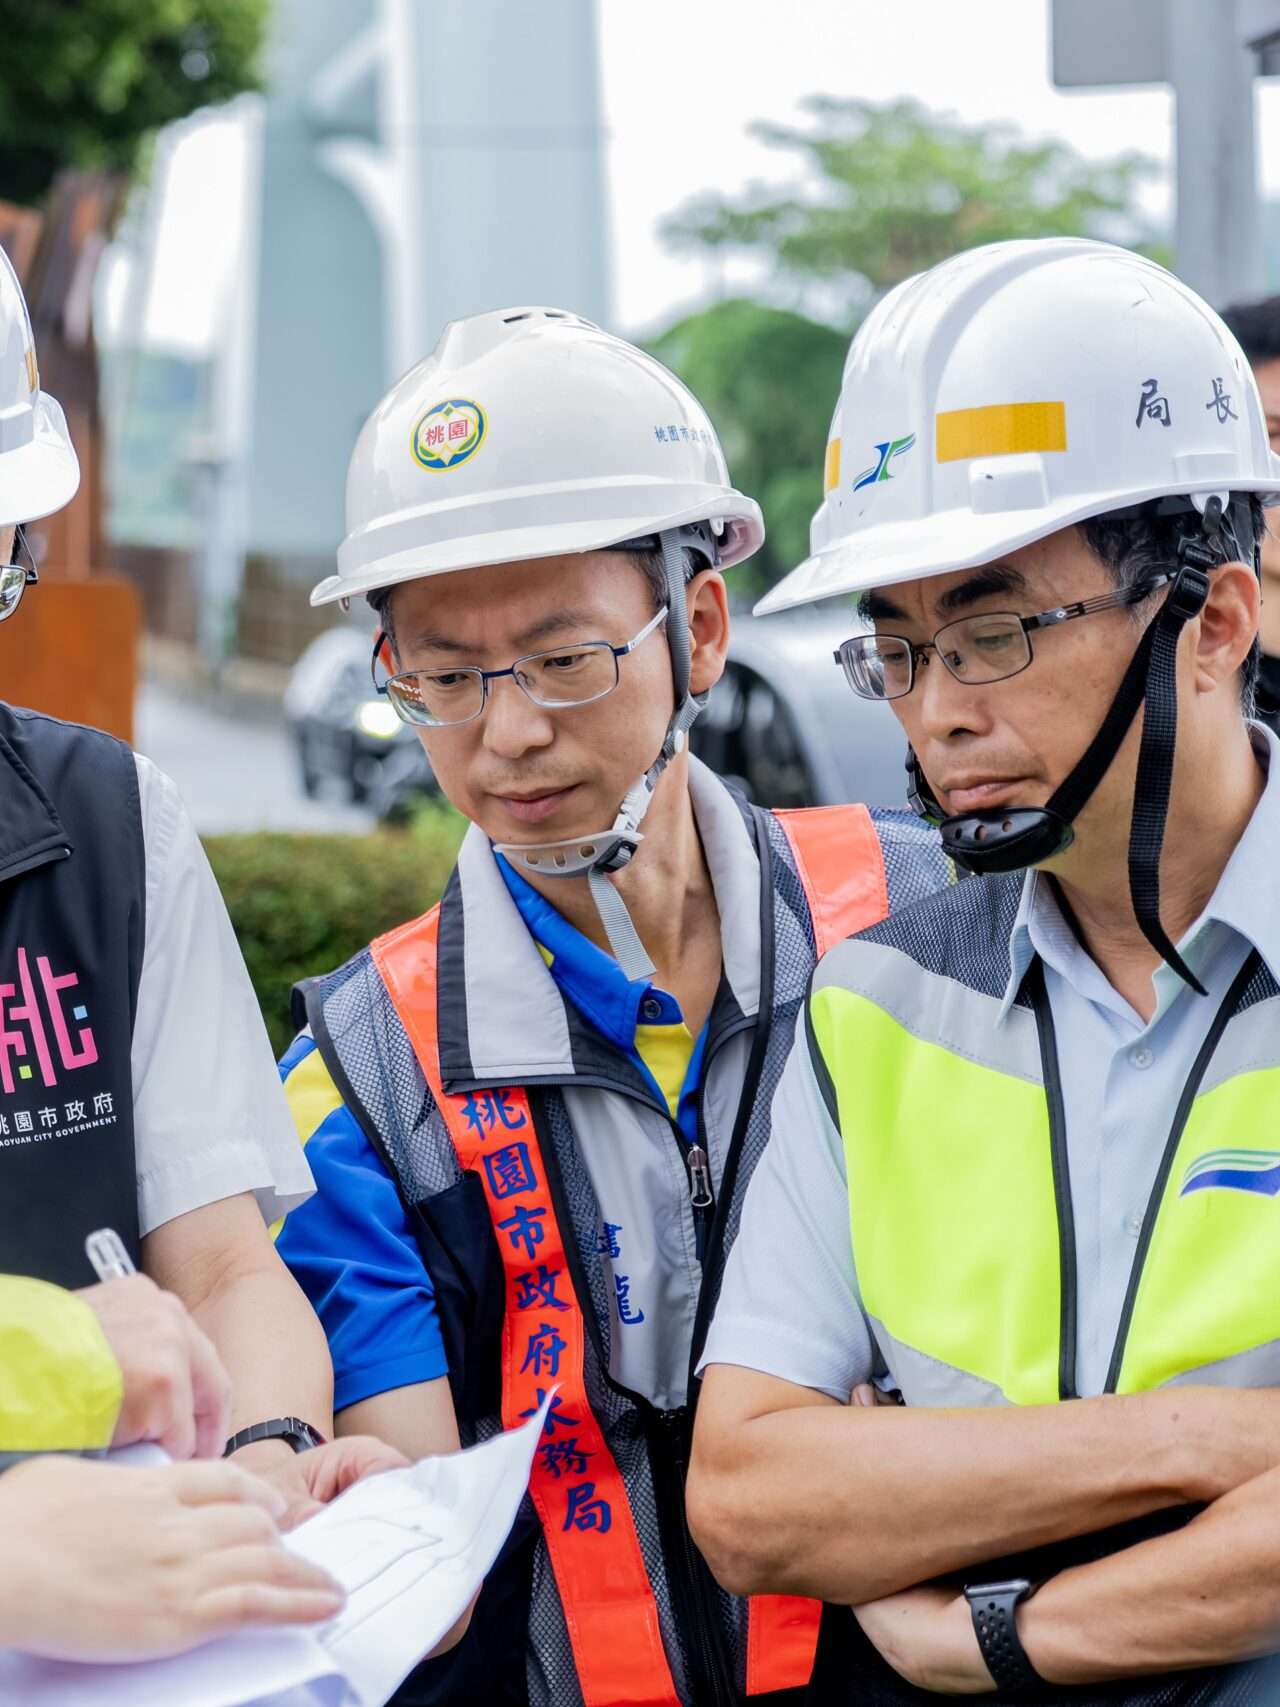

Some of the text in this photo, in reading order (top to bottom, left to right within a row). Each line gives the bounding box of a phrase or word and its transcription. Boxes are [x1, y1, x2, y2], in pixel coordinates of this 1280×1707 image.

[1135, 377, 1239, 429] 局長
[425, 419, 468, 447] 桃園
[33, 1132, 53, 1143] CITY
[55, 1115, 118, 1138] GOVERNMENT
[461, 1091, 612, 1534] 桃園市政府水務局
